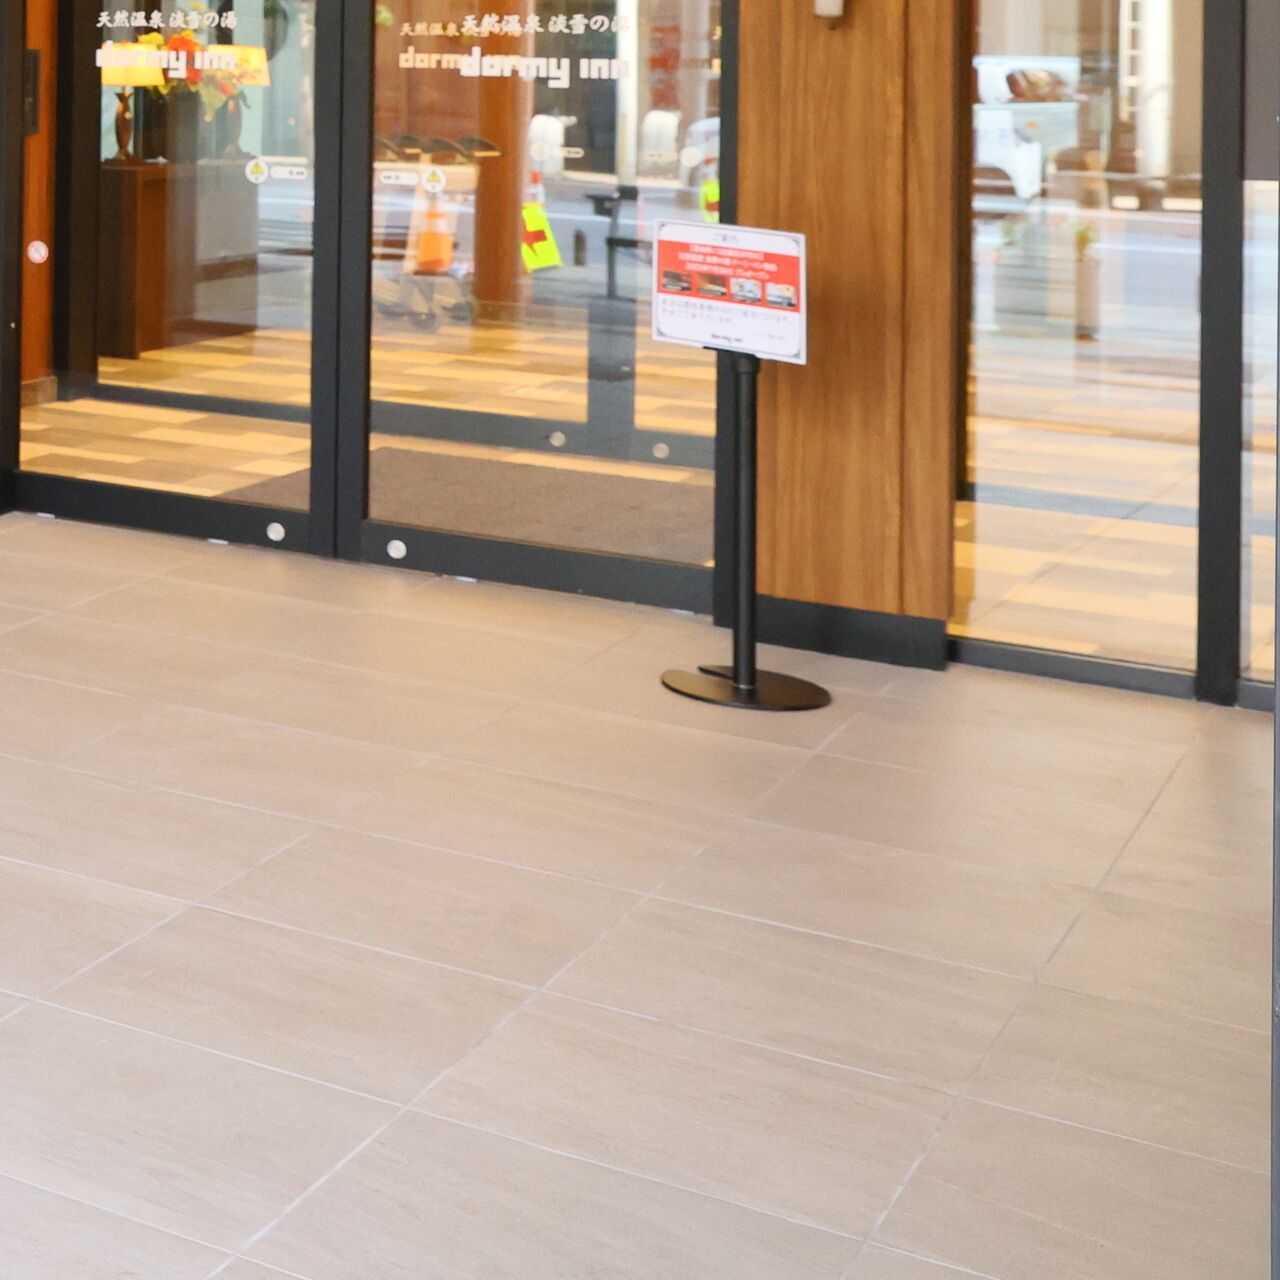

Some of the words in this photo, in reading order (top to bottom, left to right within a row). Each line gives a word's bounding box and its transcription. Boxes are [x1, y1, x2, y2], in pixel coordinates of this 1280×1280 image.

[96, 40, 187, 79] dormy
[399, 46, 462, 69] dorm
[460, 46, 571, 88] dormy
[579, 58, 630, 79] inn
